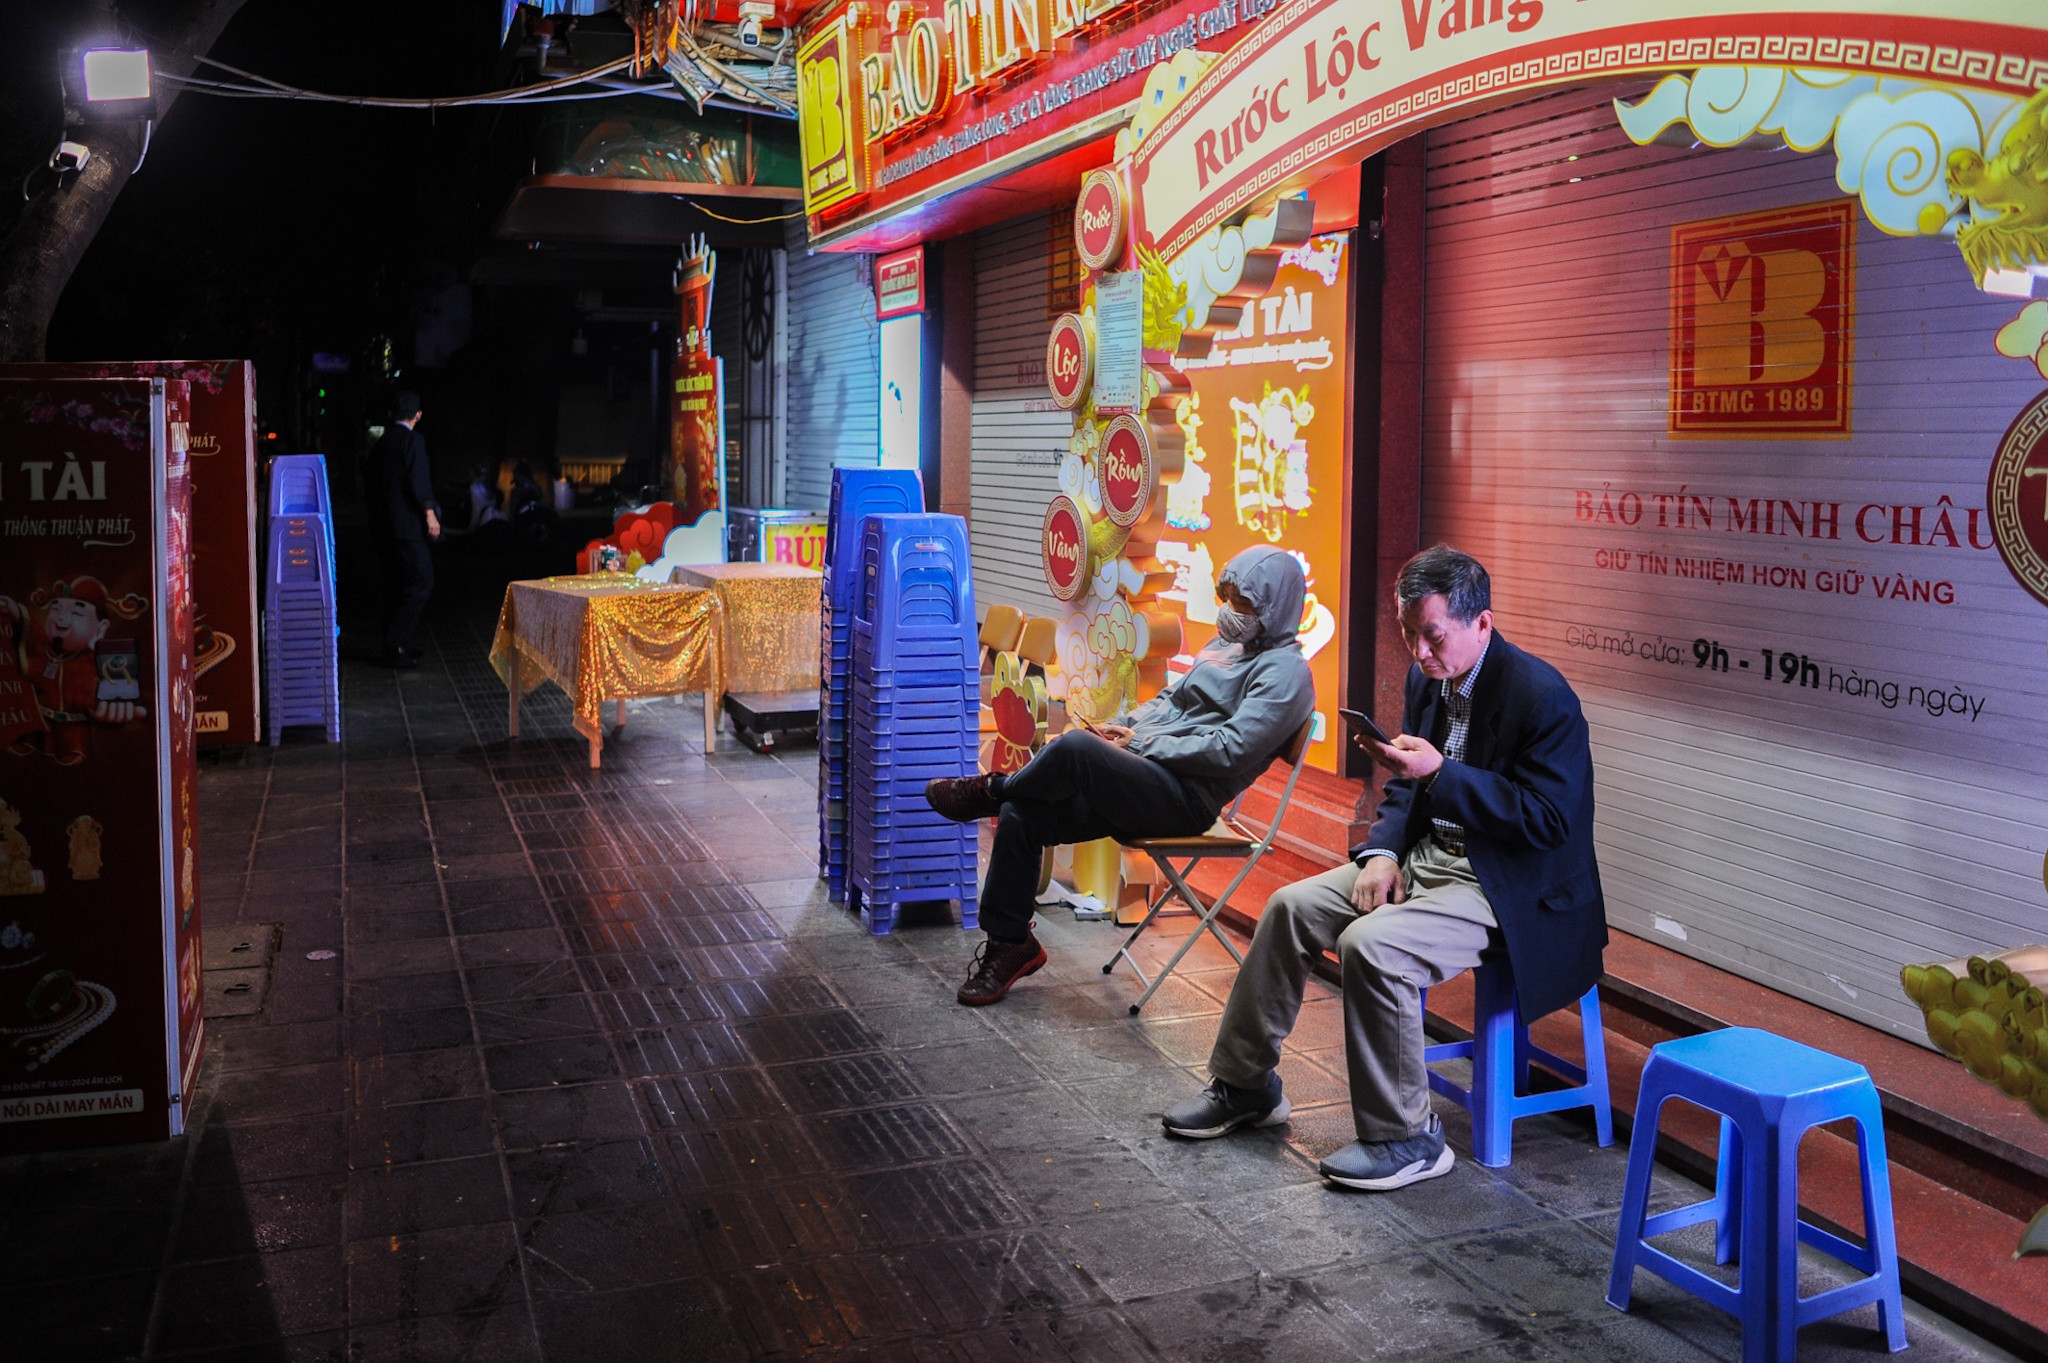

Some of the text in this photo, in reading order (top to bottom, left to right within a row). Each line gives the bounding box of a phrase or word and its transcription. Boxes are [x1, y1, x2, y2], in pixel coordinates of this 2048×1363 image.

[861, 1, 939, 145] BẢO
[1072, 63, 1108, 98] TRANG
[1109, 48, 1136, 81] SỨC
[1135, 35, 1156, 70] MỸ
[1194, 77, 1291, 191] Rước
[1304, 21, 1381, 103] Lộc
[1082, 205, 1112, 233] Rước
[1259, 286, 1313, 336] TÀI
[1053, 343, 1080, 383] Lộc
[1693, 387, 1824, 413] BTMC 1989
[21, 451, 107, 501] TÀI
[1105, 448, 1144, 498] Rồng
[4, 514, 134, 540] THÔNG THUẬN PHÁT
[1575, 481, 1995, 551] BẢO TÍN MINH CHÂU
[1048, 531, 1080, 577] Vàng
[1595, 549, 1955, 605] GIỮ TÍN NHIỆM HƠN GIỮ VÀNG
[1566, 626, 1598, 652] Giờ
[1603, 630, 1635, 657] mở
[1639, 637, 1687, 667] cửa:
[1692, 638, 1728, 673] 9h
[1763, 648, 1820, 690] 19h
[1829, 667, 1900, 708] hàng
[1908, 685, 1986, 723] ngày
[4, 1092, 133, 1118] NỐI DÀI MAY MẮN
